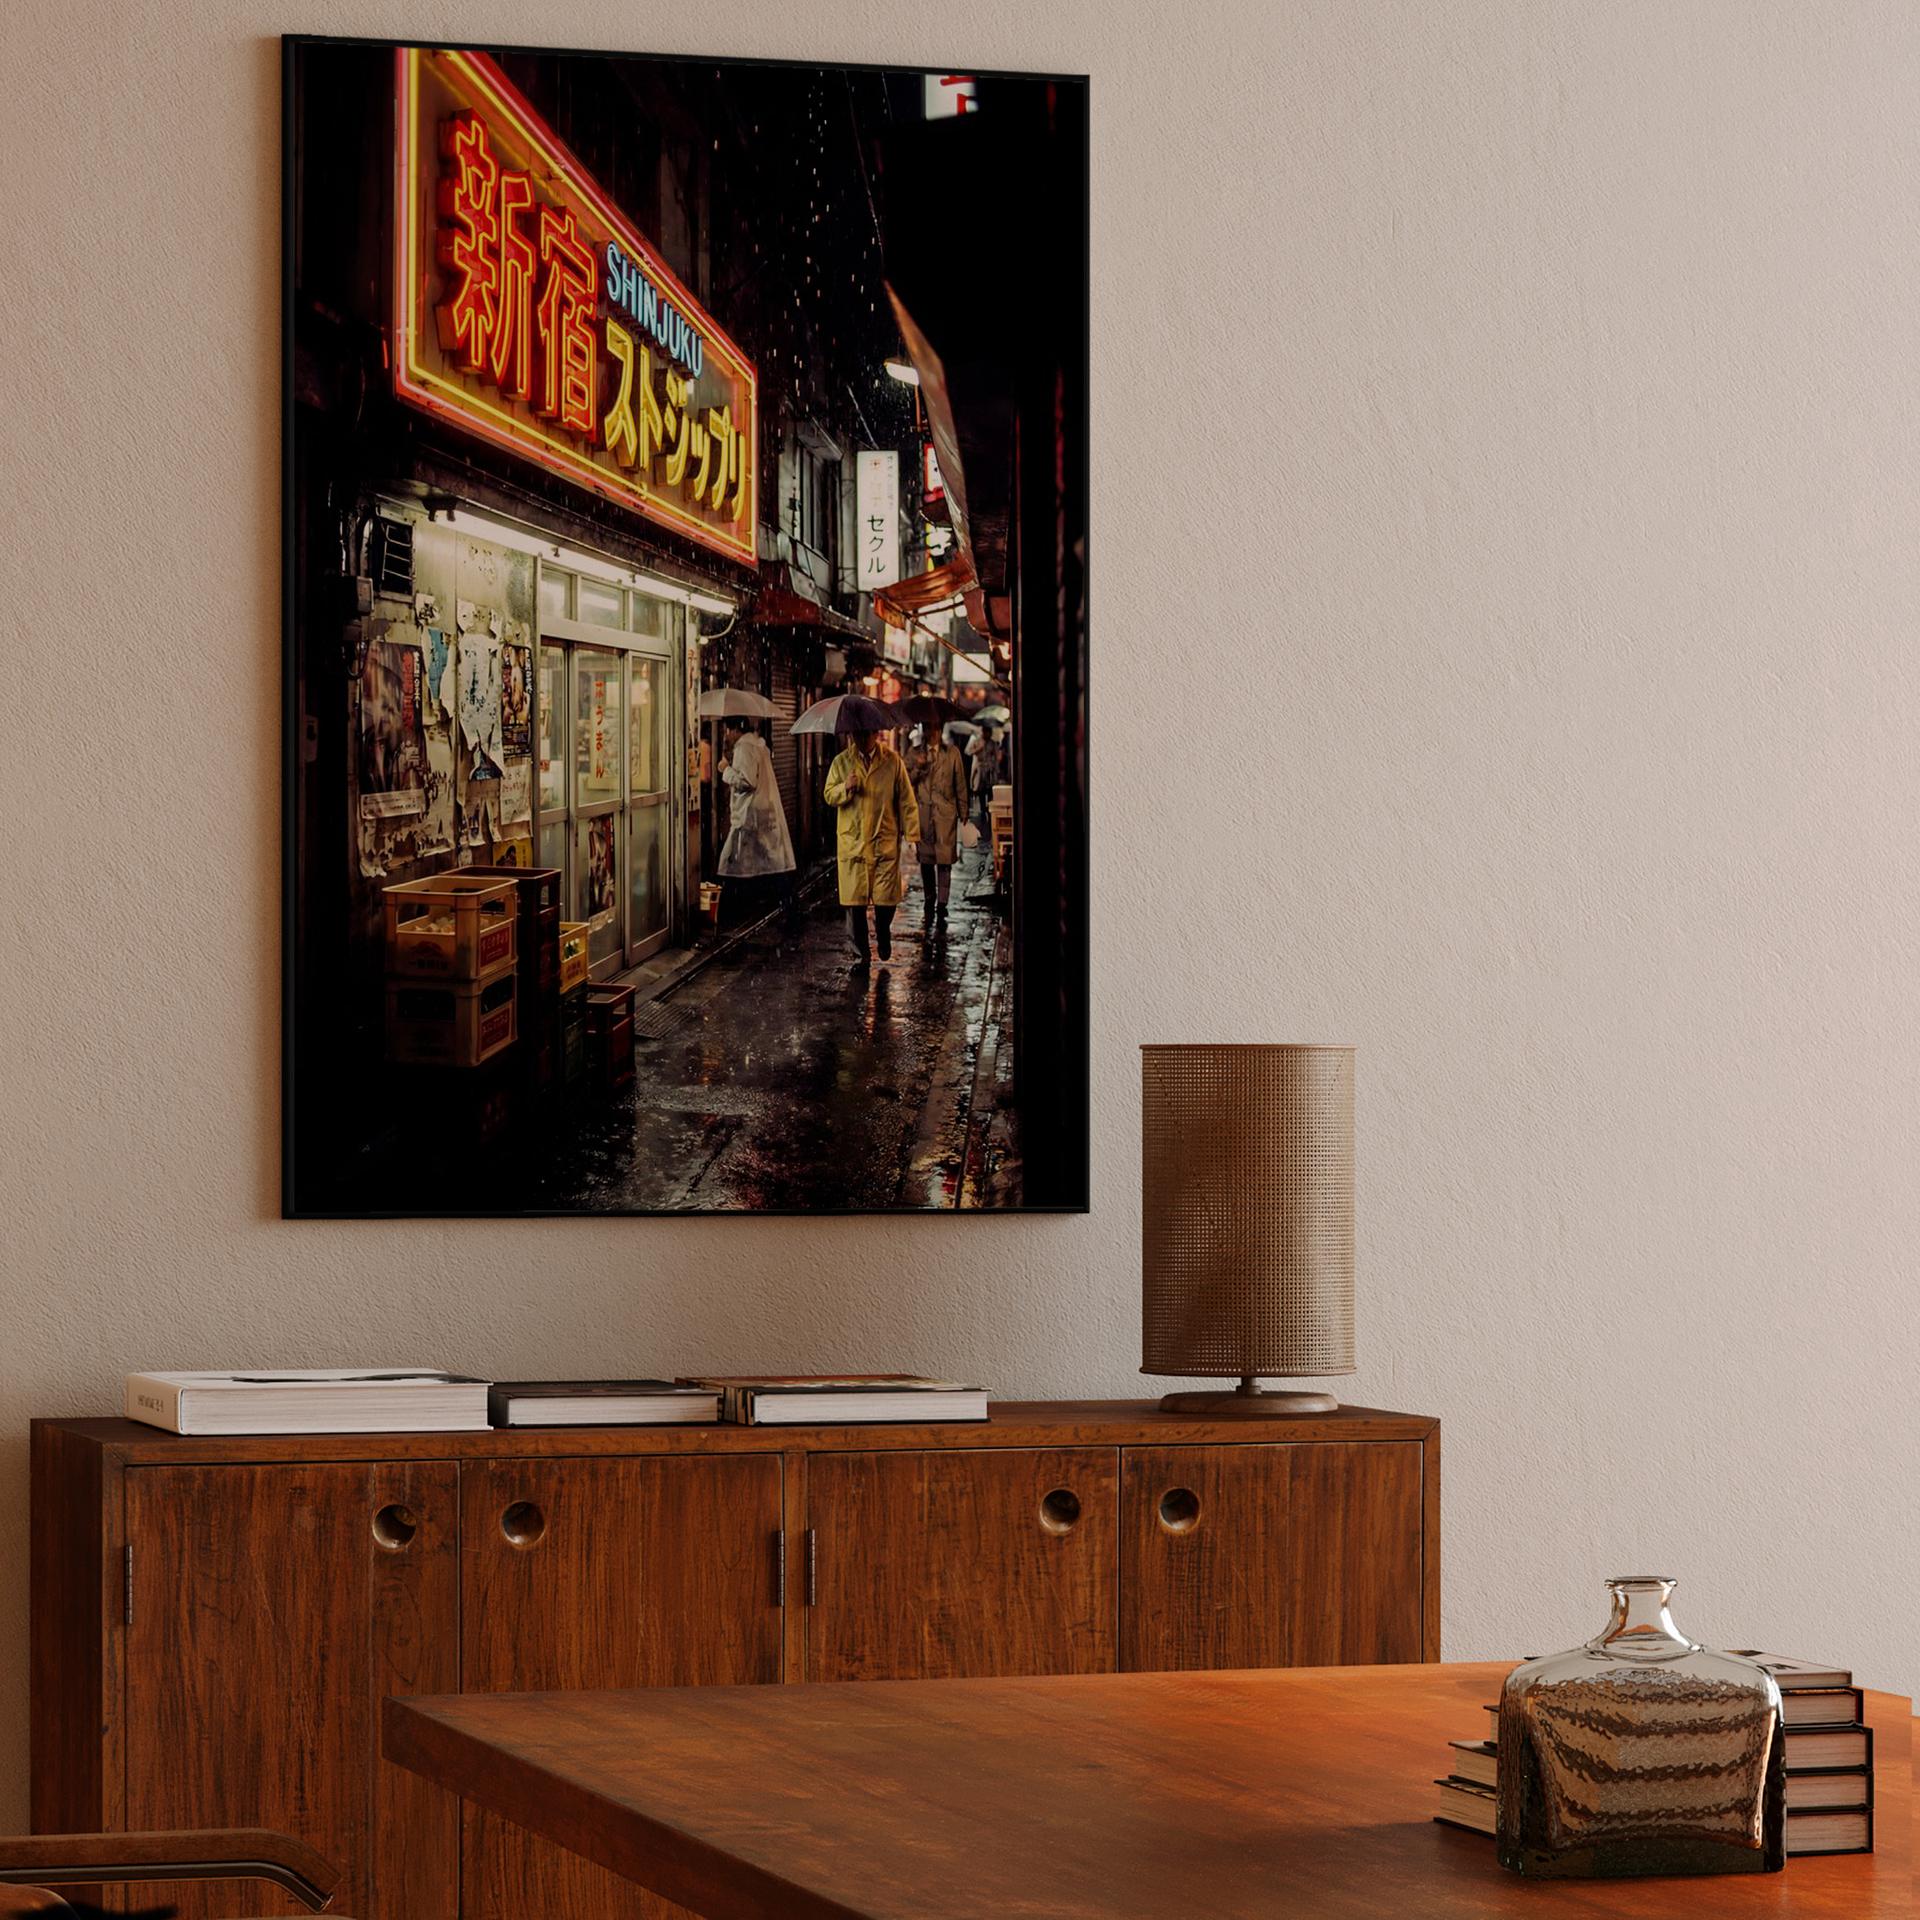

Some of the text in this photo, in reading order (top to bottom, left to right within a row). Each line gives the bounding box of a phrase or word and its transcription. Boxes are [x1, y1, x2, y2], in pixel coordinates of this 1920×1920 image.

[452, 114, 597, 437] 新宿
[607, 240, 703, 380] SHINJUKU
[866, 514, 886, 574] セクル
